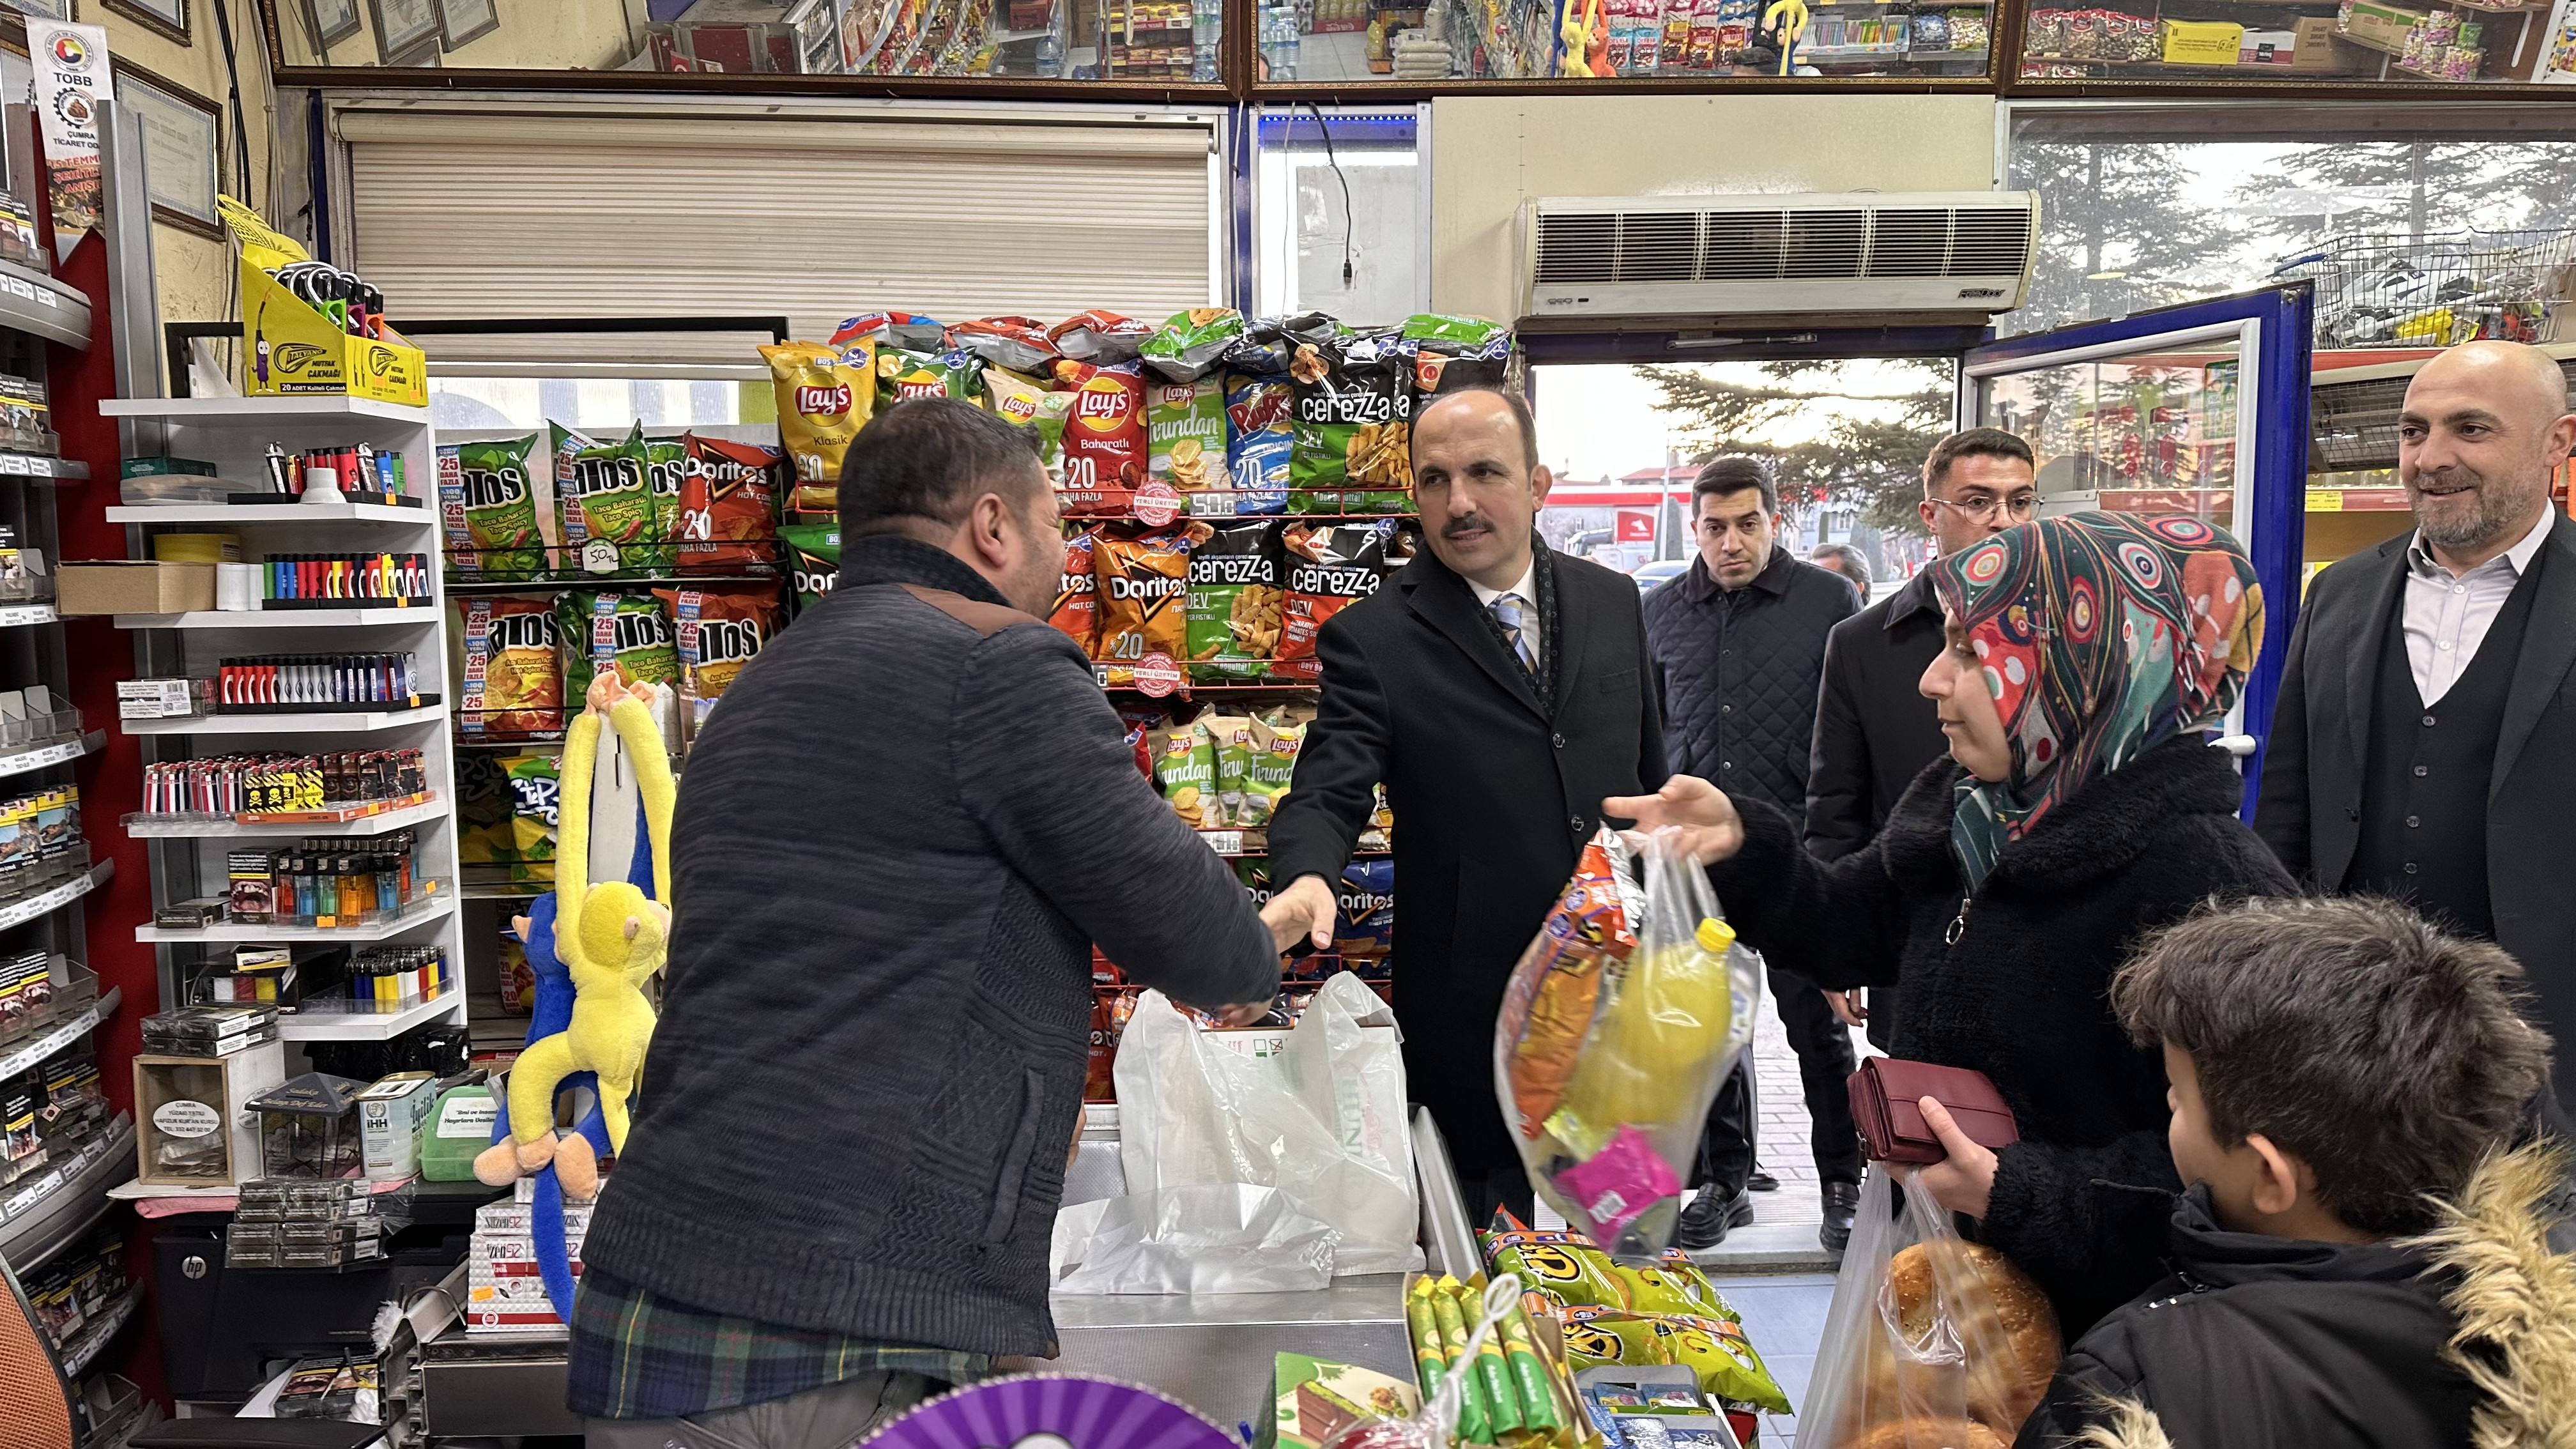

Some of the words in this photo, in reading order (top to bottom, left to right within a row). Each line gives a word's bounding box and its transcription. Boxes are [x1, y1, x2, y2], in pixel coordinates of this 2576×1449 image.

[54, 72, 93, 86] TOBB
[67, 131, 95, 139] ÇUMRA
[53, 137, 85, 148] TİCARET
[307, 369, 341, 379] ÇAKMAĞI
[1080, 391, 1127, 420] Lay's
[814, 435, 848, 446] Klasik
[1080, 438, 1130, 449] Baharatlı
[440, 457, 458, 470] 25
[560, 452, 571, 465] 25
[565, 497, 579, 508] 25
[1082, 492, 1102, 501] FAZLA
[446, 504, 464, 515] 25
[594, 504, 611, 513] Taco
[612, 496, 647, 510] Baharatlı
[479, 519, 496, 527] Taco
[498, 505, 530, 525] Baharatlı
[603, 514, 621, 523] Taco
[622, 509, 643, 518] Spicy
[489, 526, 507, 534] Taco
[509, 518, 528, 529] Spicy
[696, 544, 717, 553] FAZLA
[590, 549, 607, 564] 50
[607, 555, 619, 564] TL
[1111, 576, 1186, 599] Doritos
[471, 614, 487, 623] 25
[597, 618, 614, 630] 25
[682, 622, 698, 634] 25
[470, 656, 486, 666] 25
[629, 659, 645, 668] Taco
[636, 669, 654, 677] Taco
[656, 664, 675, 675] Spicy
[466, 697, 482, 708] 25
[1340, 893, 1393, 910] oritos
[187, 1256, 202, 1279] hp
